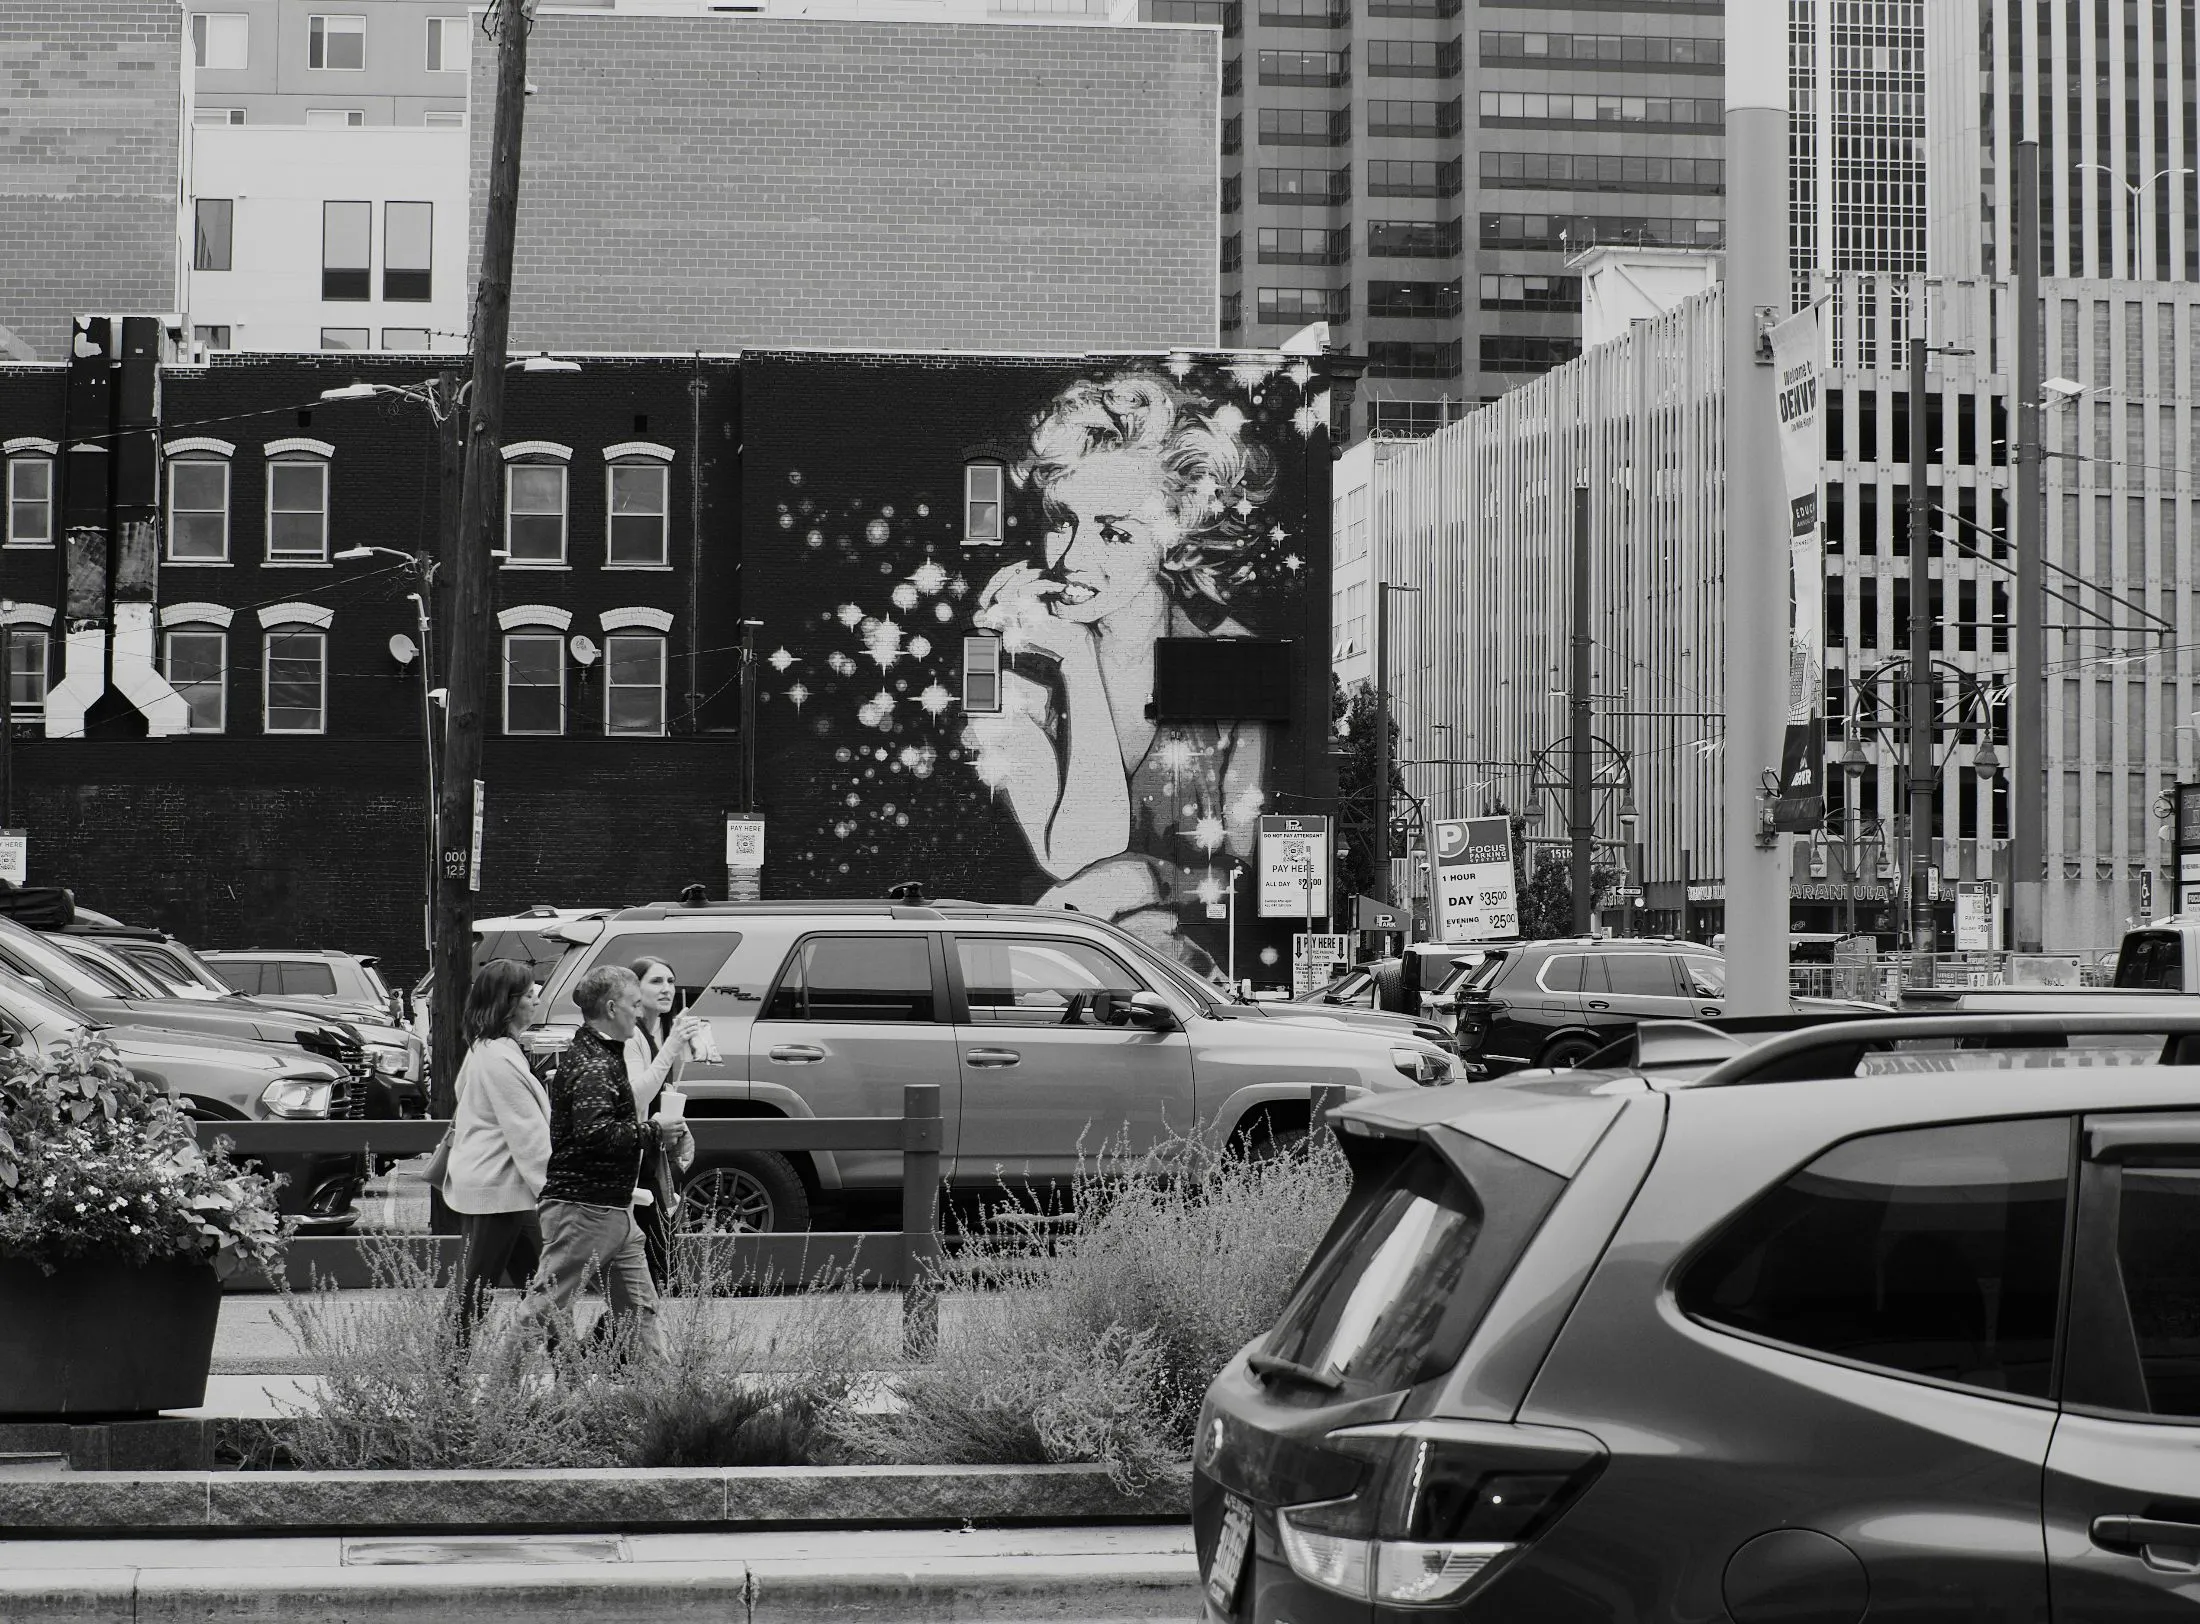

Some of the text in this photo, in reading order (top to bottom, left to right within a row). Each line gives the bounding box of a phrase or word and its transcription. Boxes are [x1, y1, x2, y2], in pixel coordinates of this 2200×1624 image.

[1469, 844, 1506, 853] FOCUS
[1470, 851, 1507, 859] PARKING
[1551, 849, 1573, 858] 15th
[446, 865, 466, 875] 125
[1272, 864, 1289, 873] PAY
[1450, 873, 1476, 882] HOUR
[1789, 884, 1888, 901] ARANTULA
[1448, 896, 1474, 907] DAY
[1447, 916, 1480, 925] EVENING
[1303, 937, 1336, 949] PY HERE
